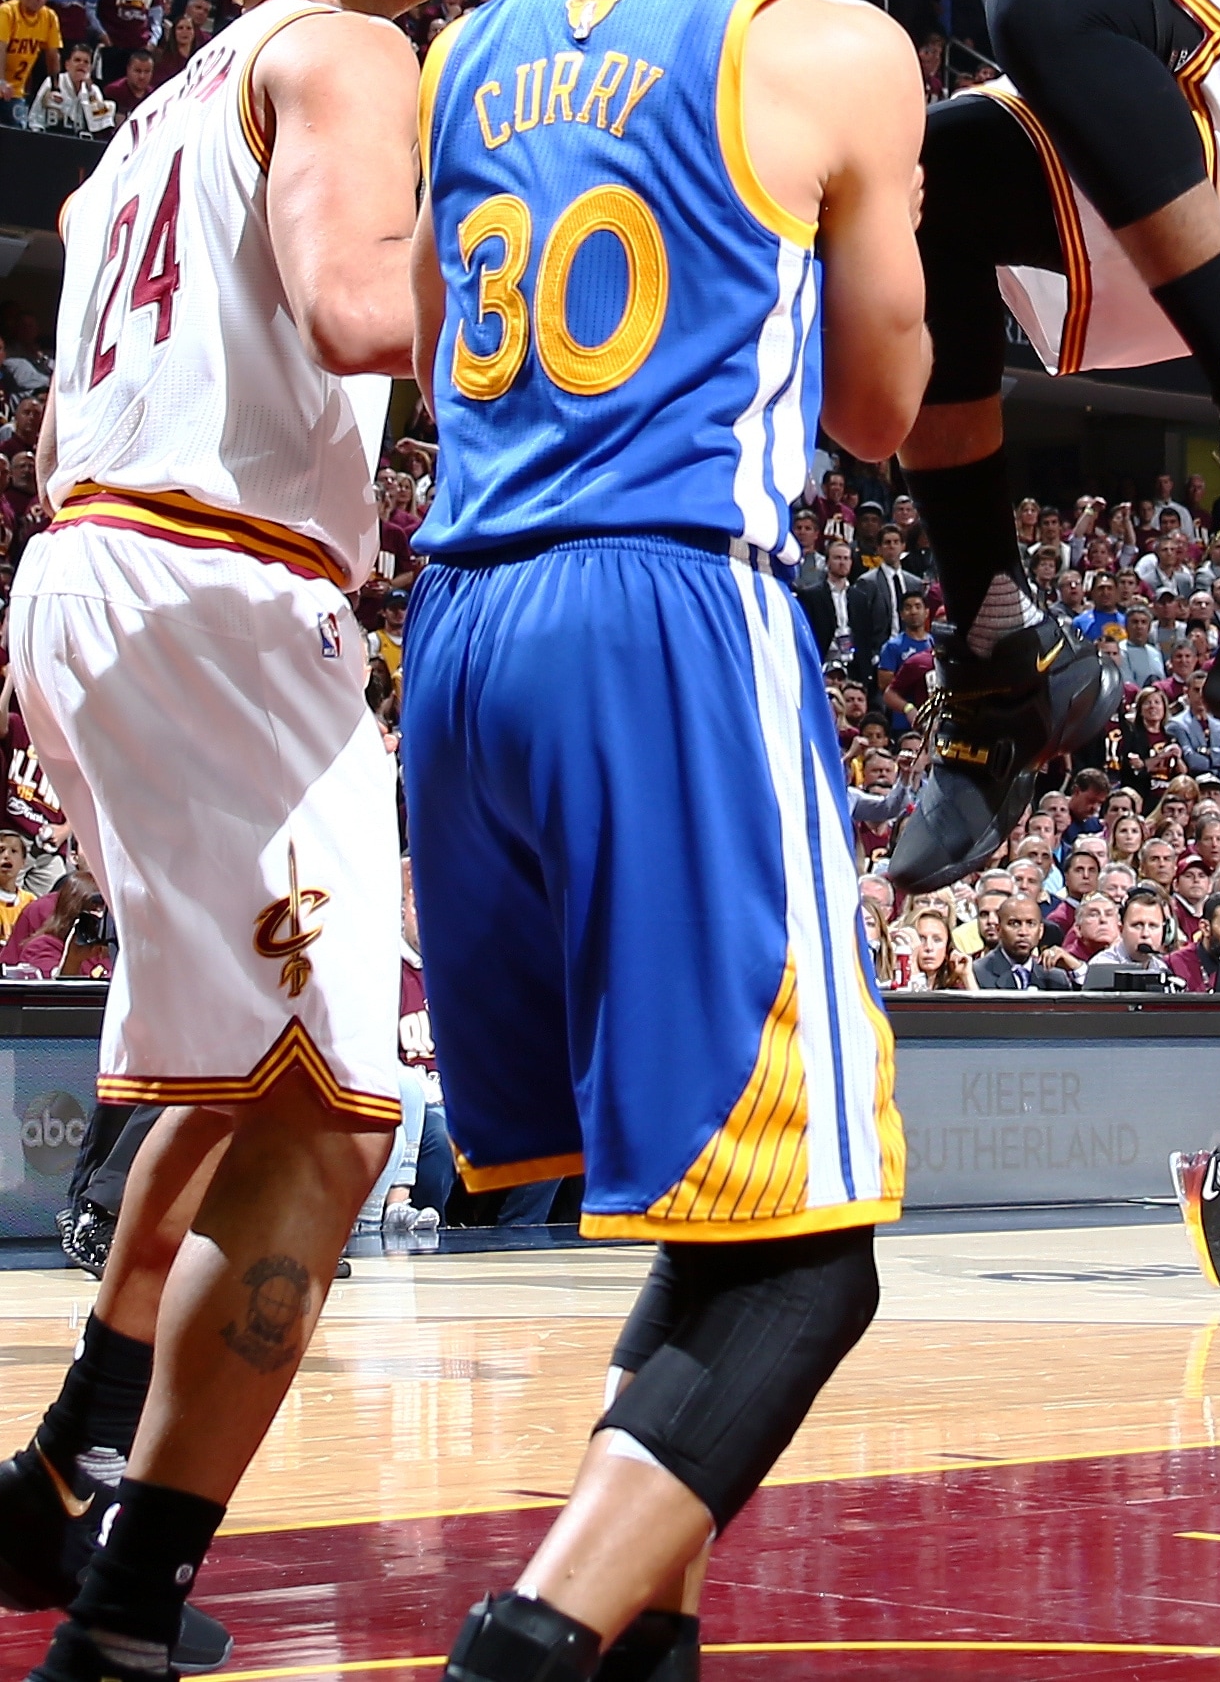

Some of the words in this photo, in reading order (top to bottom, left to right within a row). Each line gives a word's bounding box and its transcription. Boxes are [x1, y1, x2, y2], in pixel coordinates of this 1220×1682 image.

[14, 61, 28, 81] 2
[474, 51, 664, 150] CURRY
[89, 146, 184, 392] 24
[452, 184, 669, 401] 30
[961, 1071, 1083, 1116] KIEFER
[21, 1108, 86, 1149] abc
[906, 1121, 1140, 1173] SUTHERLAND
